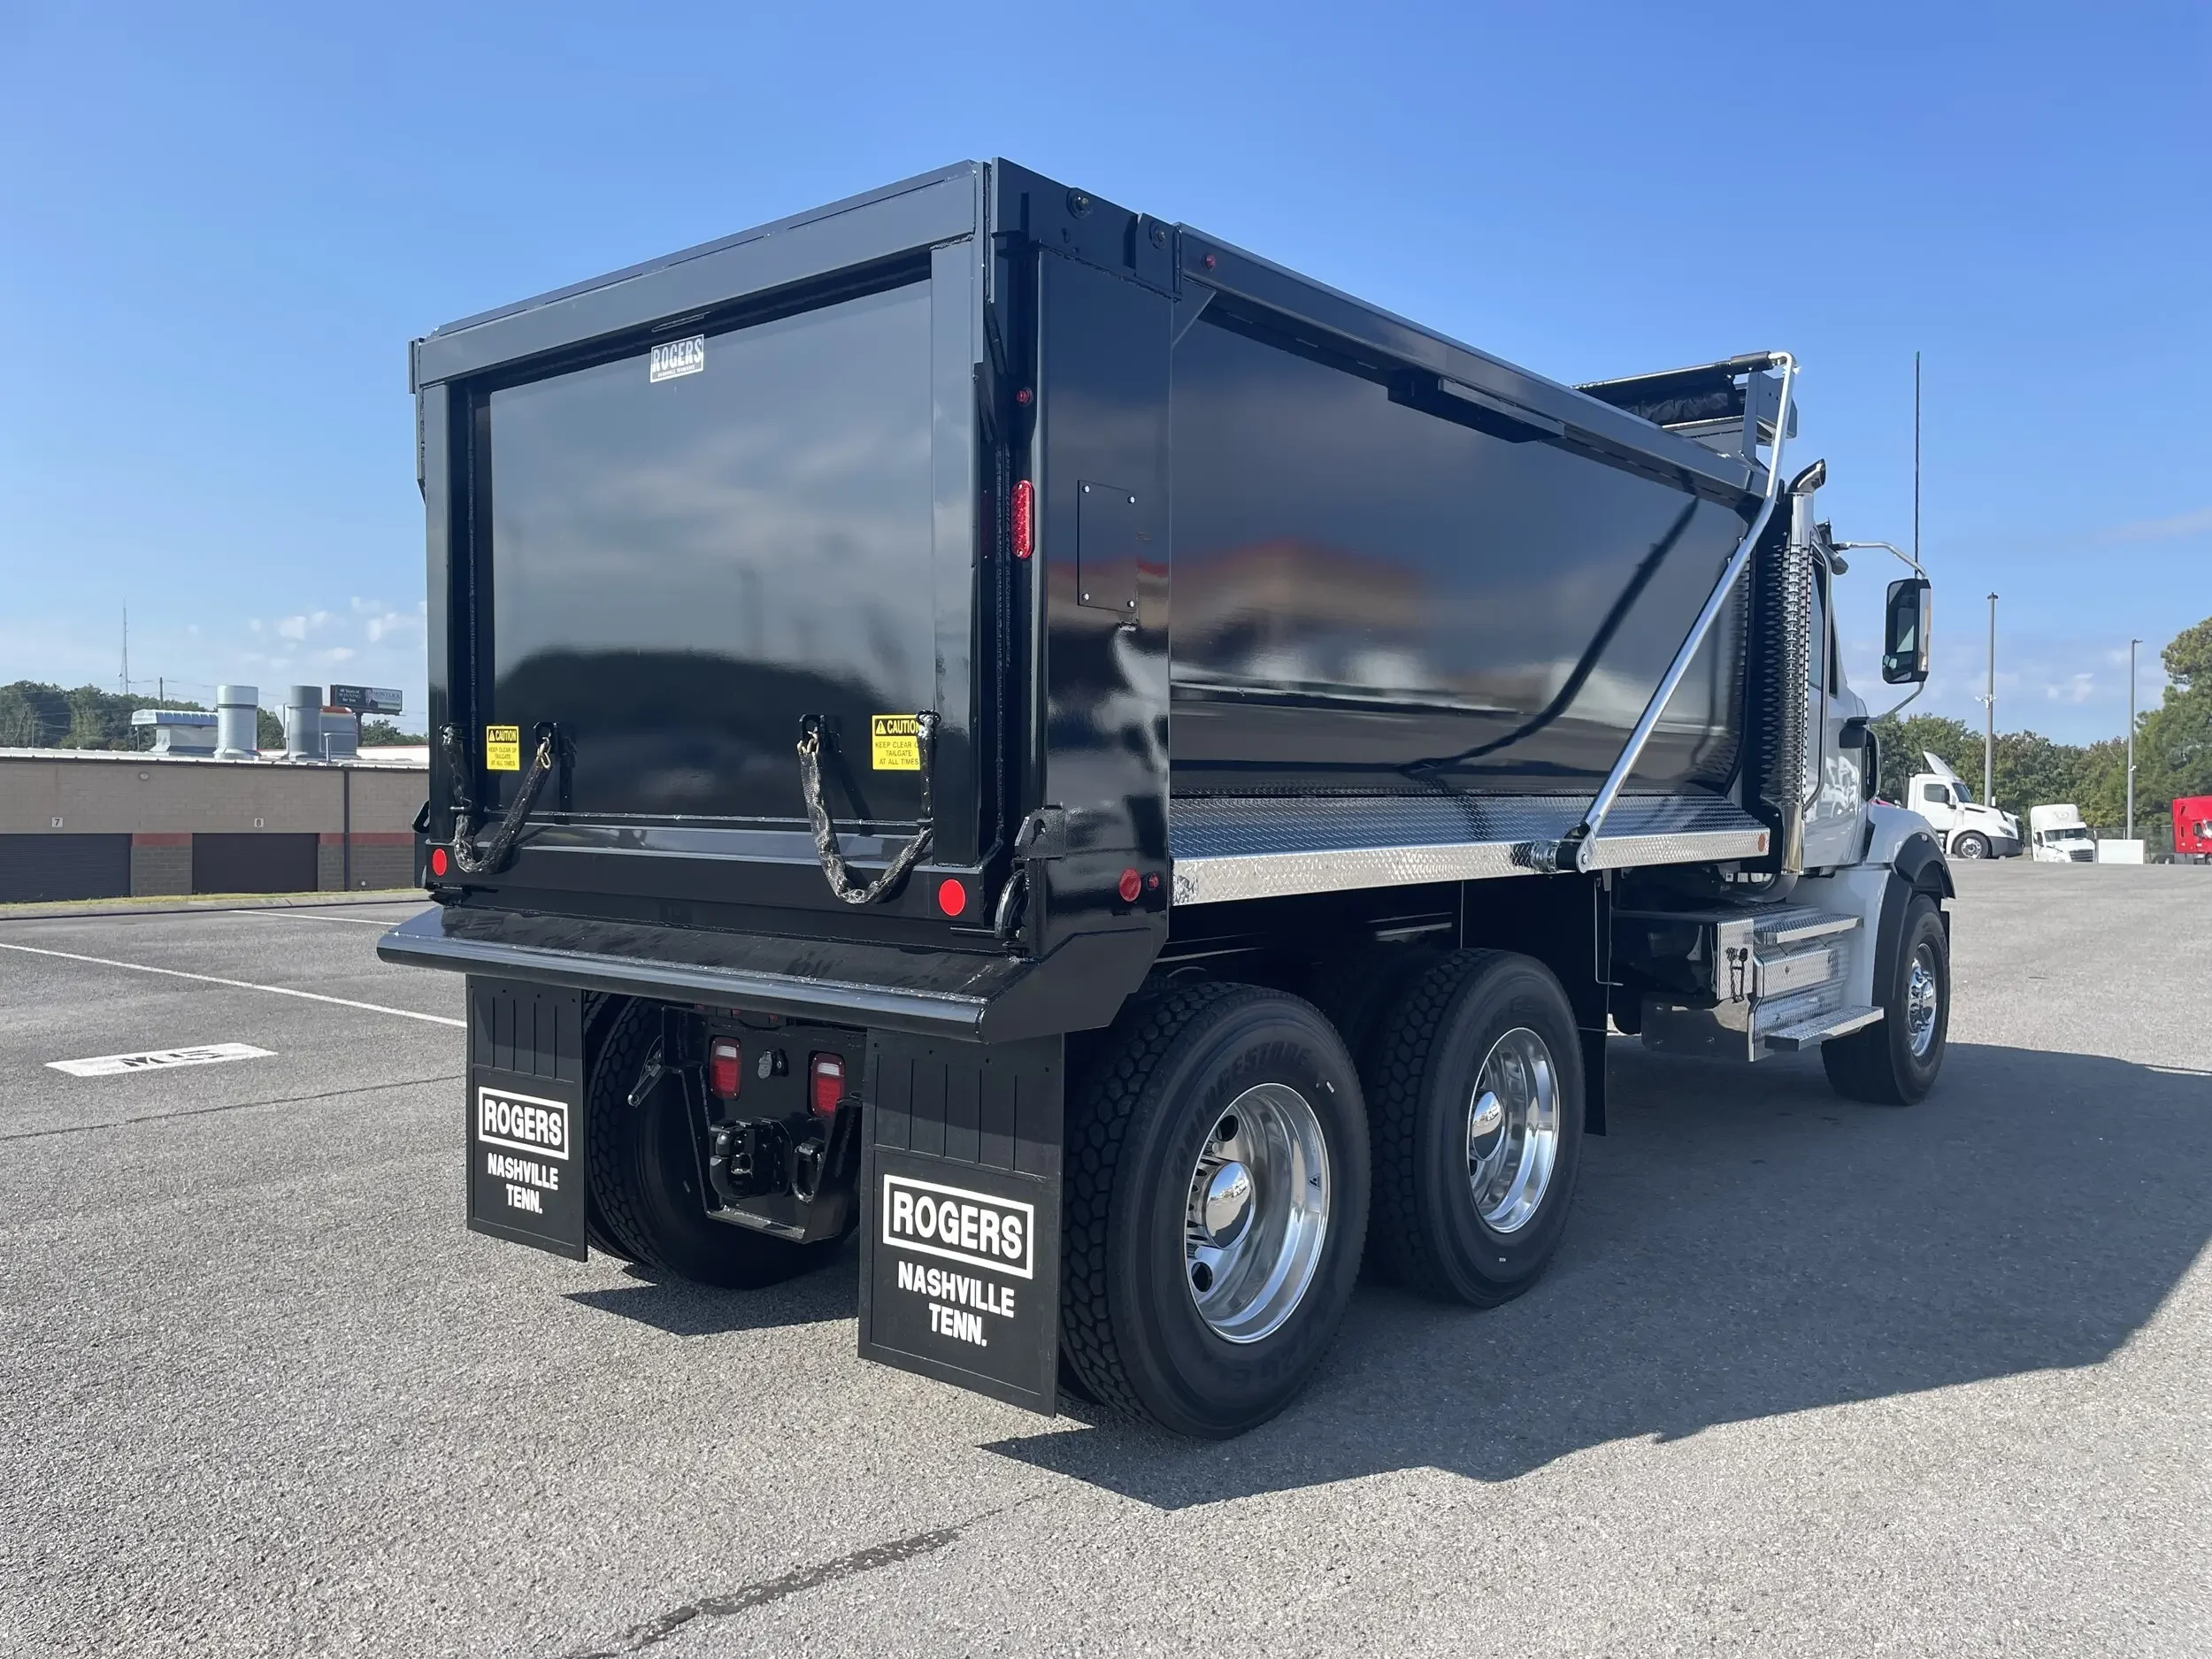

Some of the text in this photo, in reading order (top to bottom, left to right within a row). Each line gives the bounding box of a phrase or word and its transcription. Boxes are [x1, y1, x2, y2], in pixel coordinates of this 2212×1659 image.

[653, 338, 703, 373] ROGERS
[495, 729, 517, 741] CAUTION
[484, 1098, 563, 1147] ROGERS
[488, 1152, 559, 1191] NASHVILLE
[505, 1183, 543, 1215] TENN.
[893, 1190, 1023, 1260] ROGERS
[897, 1260, 1015, 1318] NASHVILLE
[928, 1302, 987, 1348] TENN.
